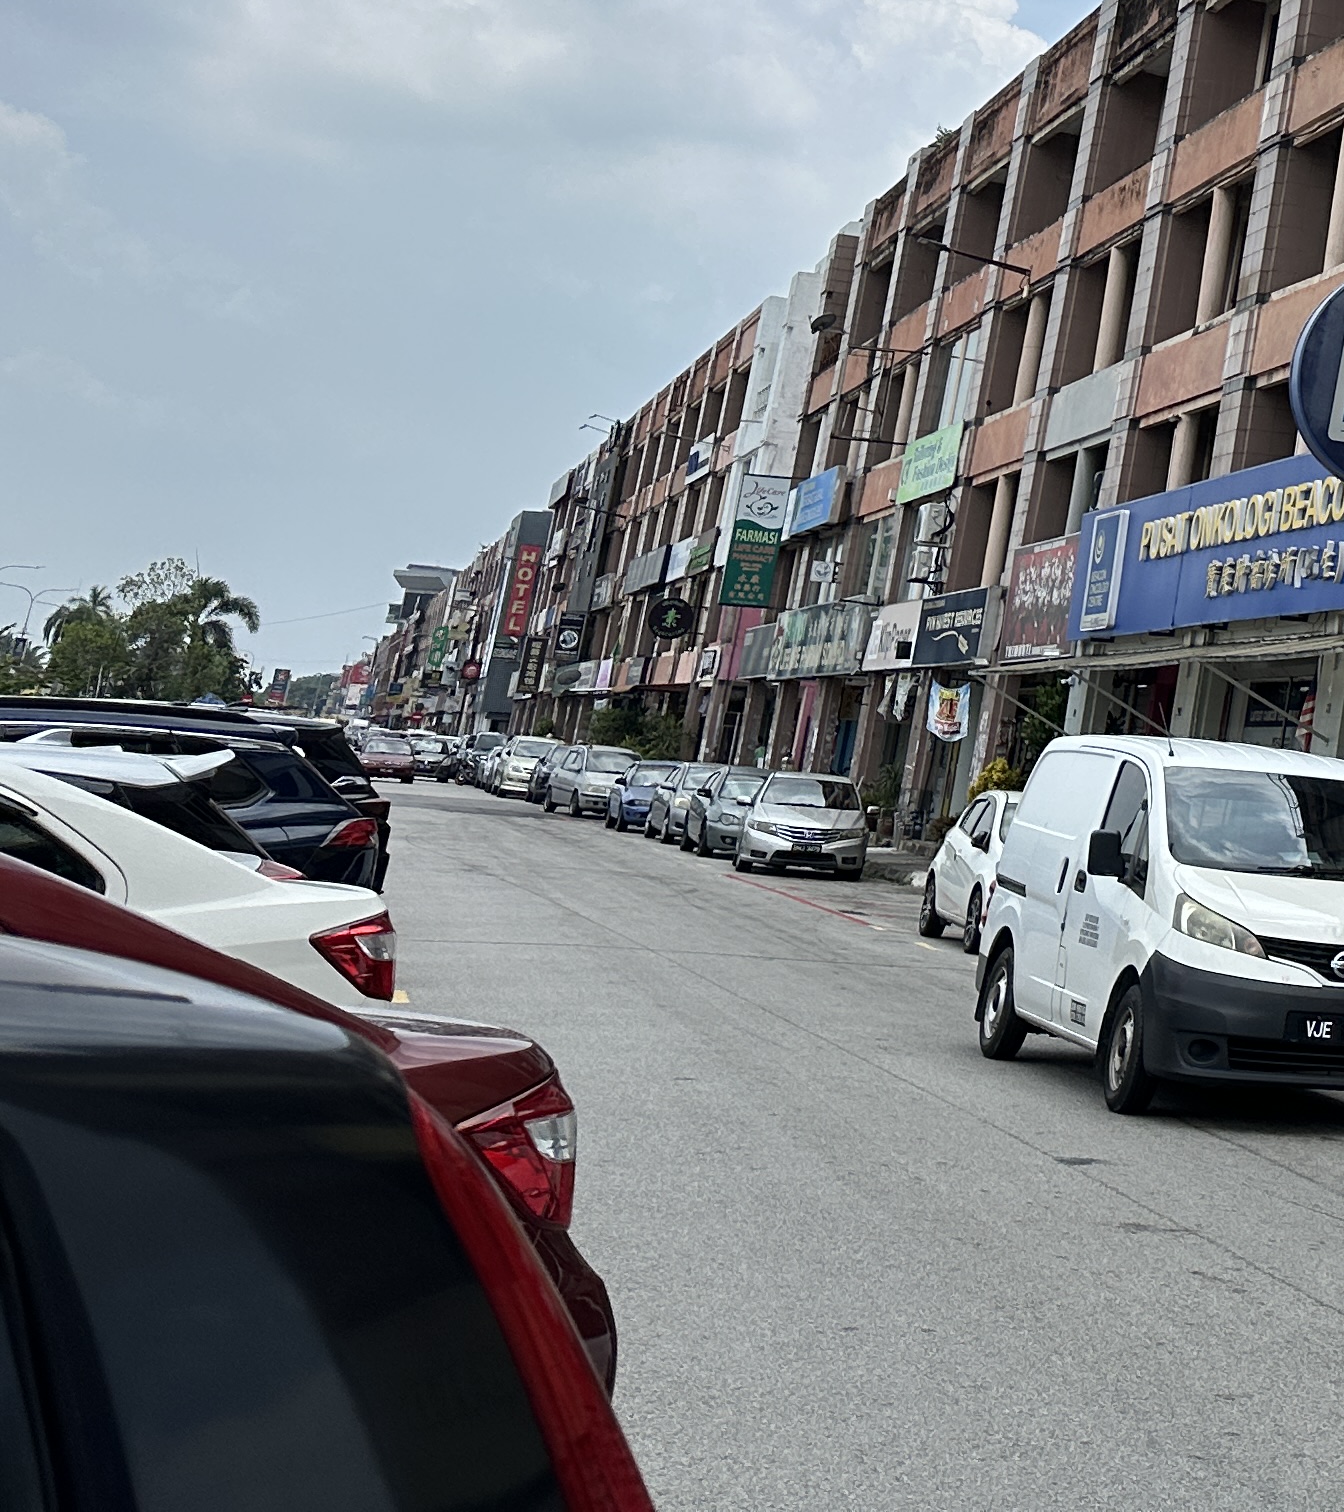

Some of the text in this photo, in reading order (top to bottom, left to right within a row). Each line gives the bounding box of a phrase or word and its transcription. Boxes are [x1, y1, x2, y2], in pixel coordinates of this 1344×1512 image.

[735, 528, 779, 545] FARMASI
[1139, 511, 1194, 562] PUSAT
[1190, 488, 1283, 551] ONKOLOGI
[508, 550, 537, 632] HOTEL
[1306, 1020, 1333, 1039] VJE
